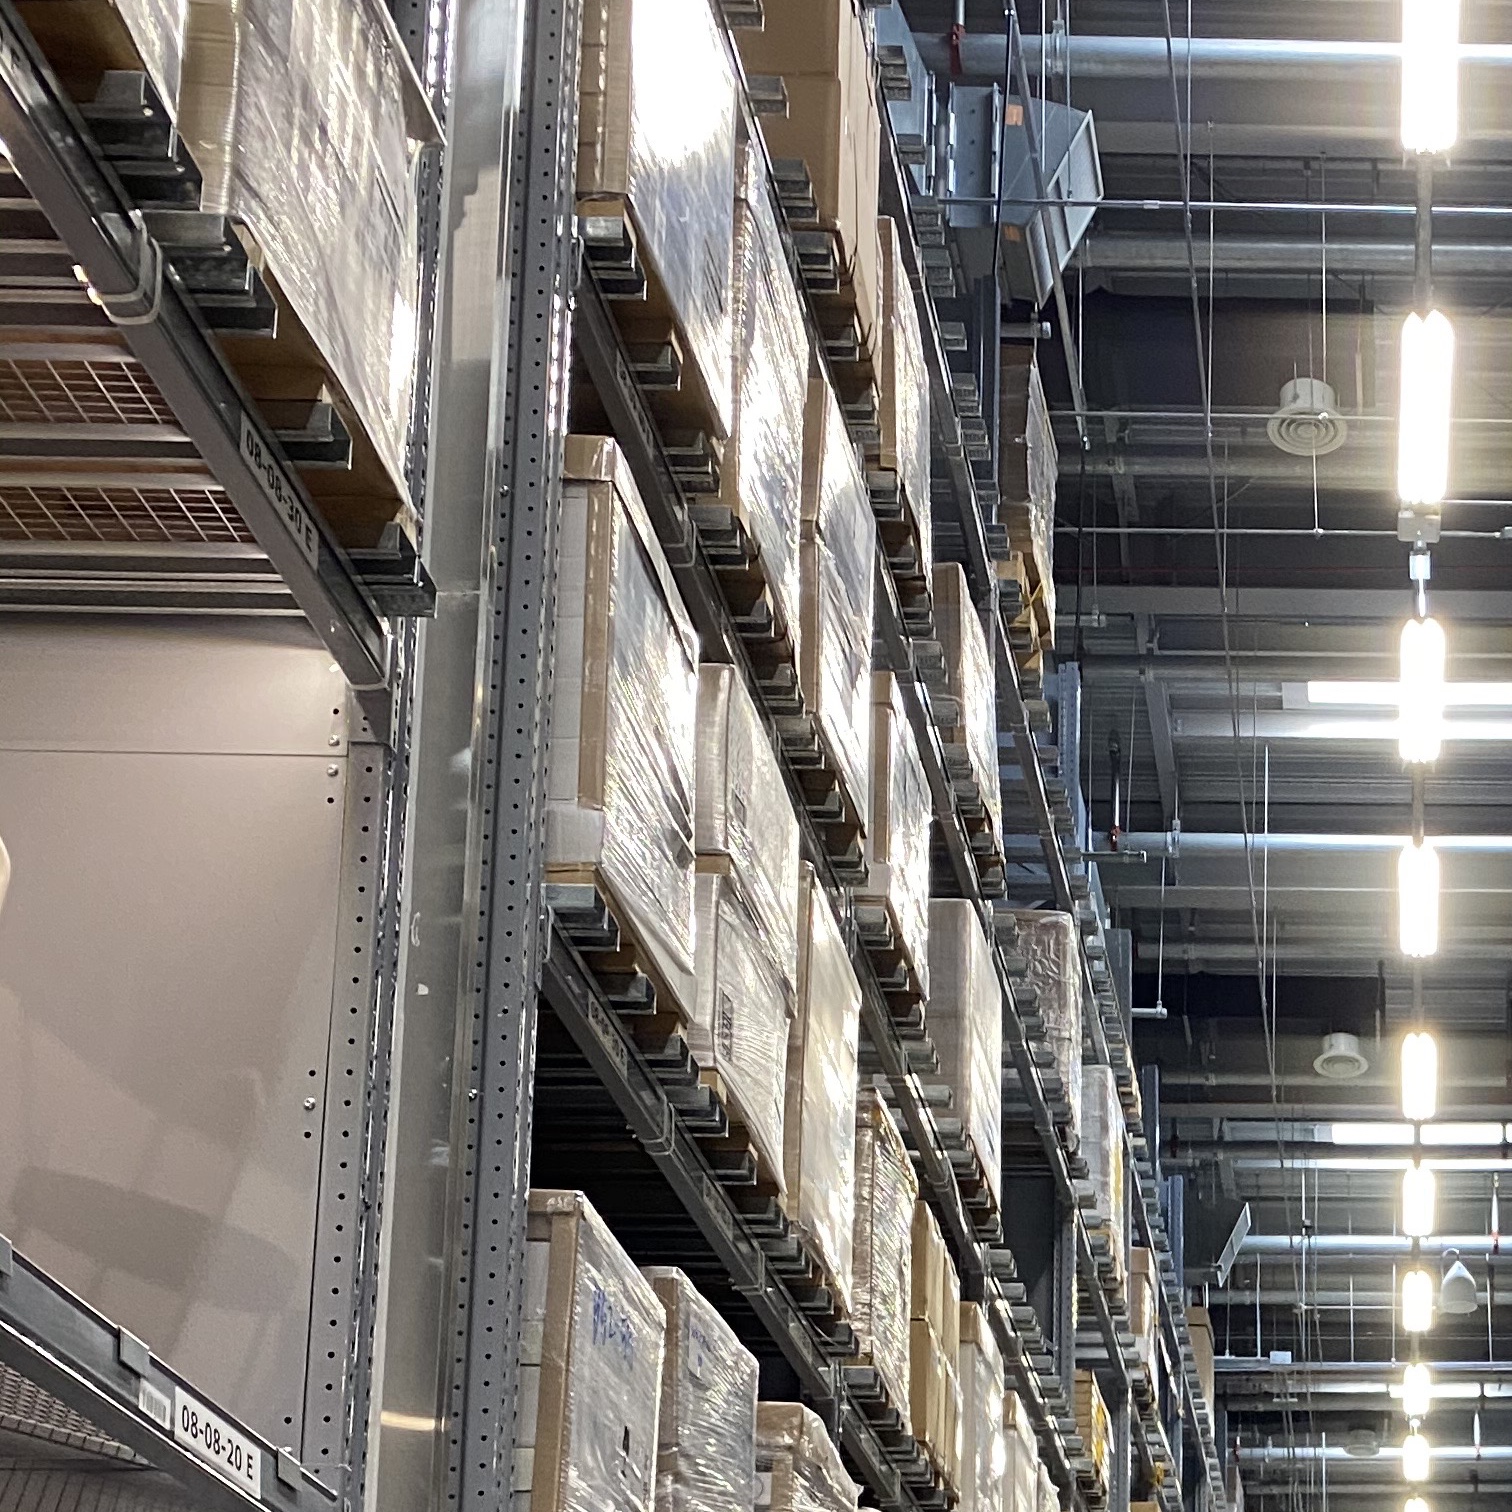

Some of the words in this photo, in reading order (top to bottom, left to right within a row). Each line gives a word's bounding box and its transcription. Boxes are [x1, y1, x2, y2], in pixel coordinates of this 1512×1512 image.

[246, 429, 302, 535] 08-08-30
[304, 523, 313, 553] E
[182, 1404, 242, 1472] 08-08-20
[246, 1453, 254, 1481] E
